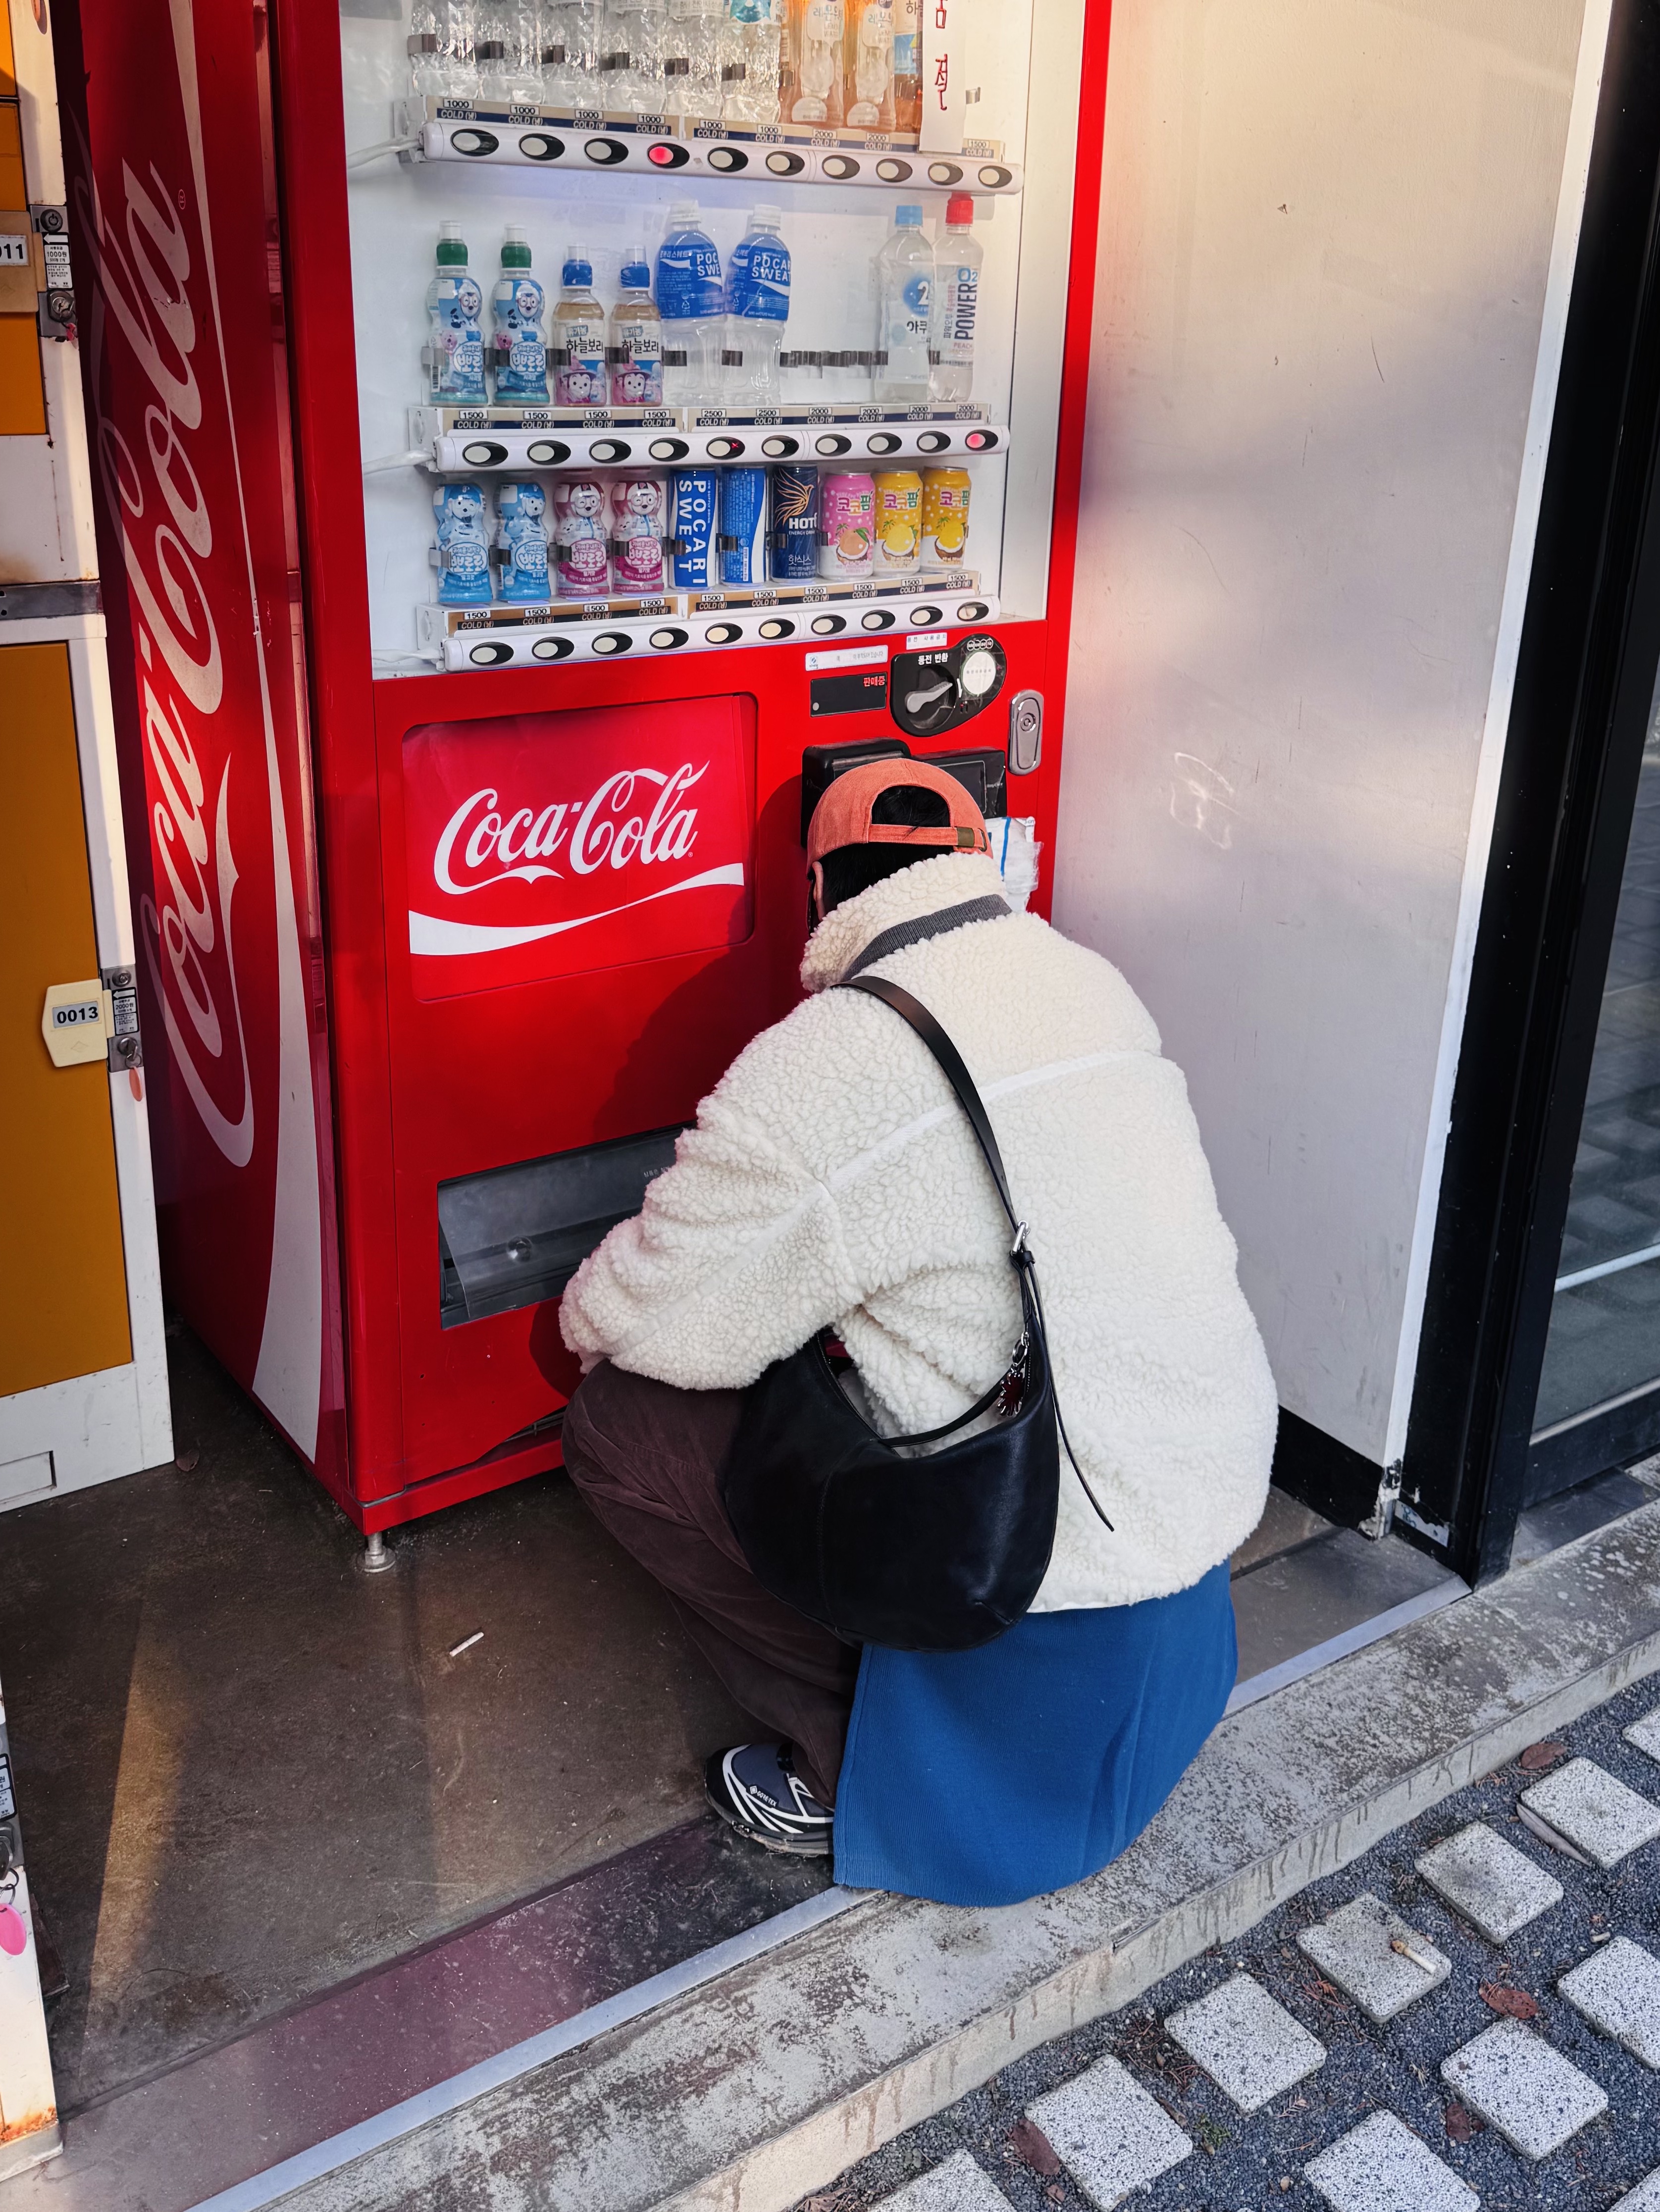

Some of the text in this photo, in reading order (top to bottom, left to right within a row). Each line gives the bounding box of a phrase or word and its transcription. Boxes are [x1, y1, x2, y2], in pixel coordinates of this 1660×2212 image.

[573, 121, 594, 129] COLD
[636, 125, 656, 133] COLD
[755, 134, 774, 142] COLD
[0, 243, 23, 259] 11
[954, 283, 978, 340] POWER
[566, 337, 603, 354] 하늘보리
[837, 493, 871, 515] 코코팜
[884, 489, 919, 511] 코코팜
[693, 480, 707, 583] POCARI
[66, 100, 254, 1169] Coca-Cola
[918, 653, 948, 666] 동전 반환
[863, 675, 885, 687] 판매중
[434, 760, 710, 895] Coca-Cola
[57, 1006, 98, 1024] 0013
